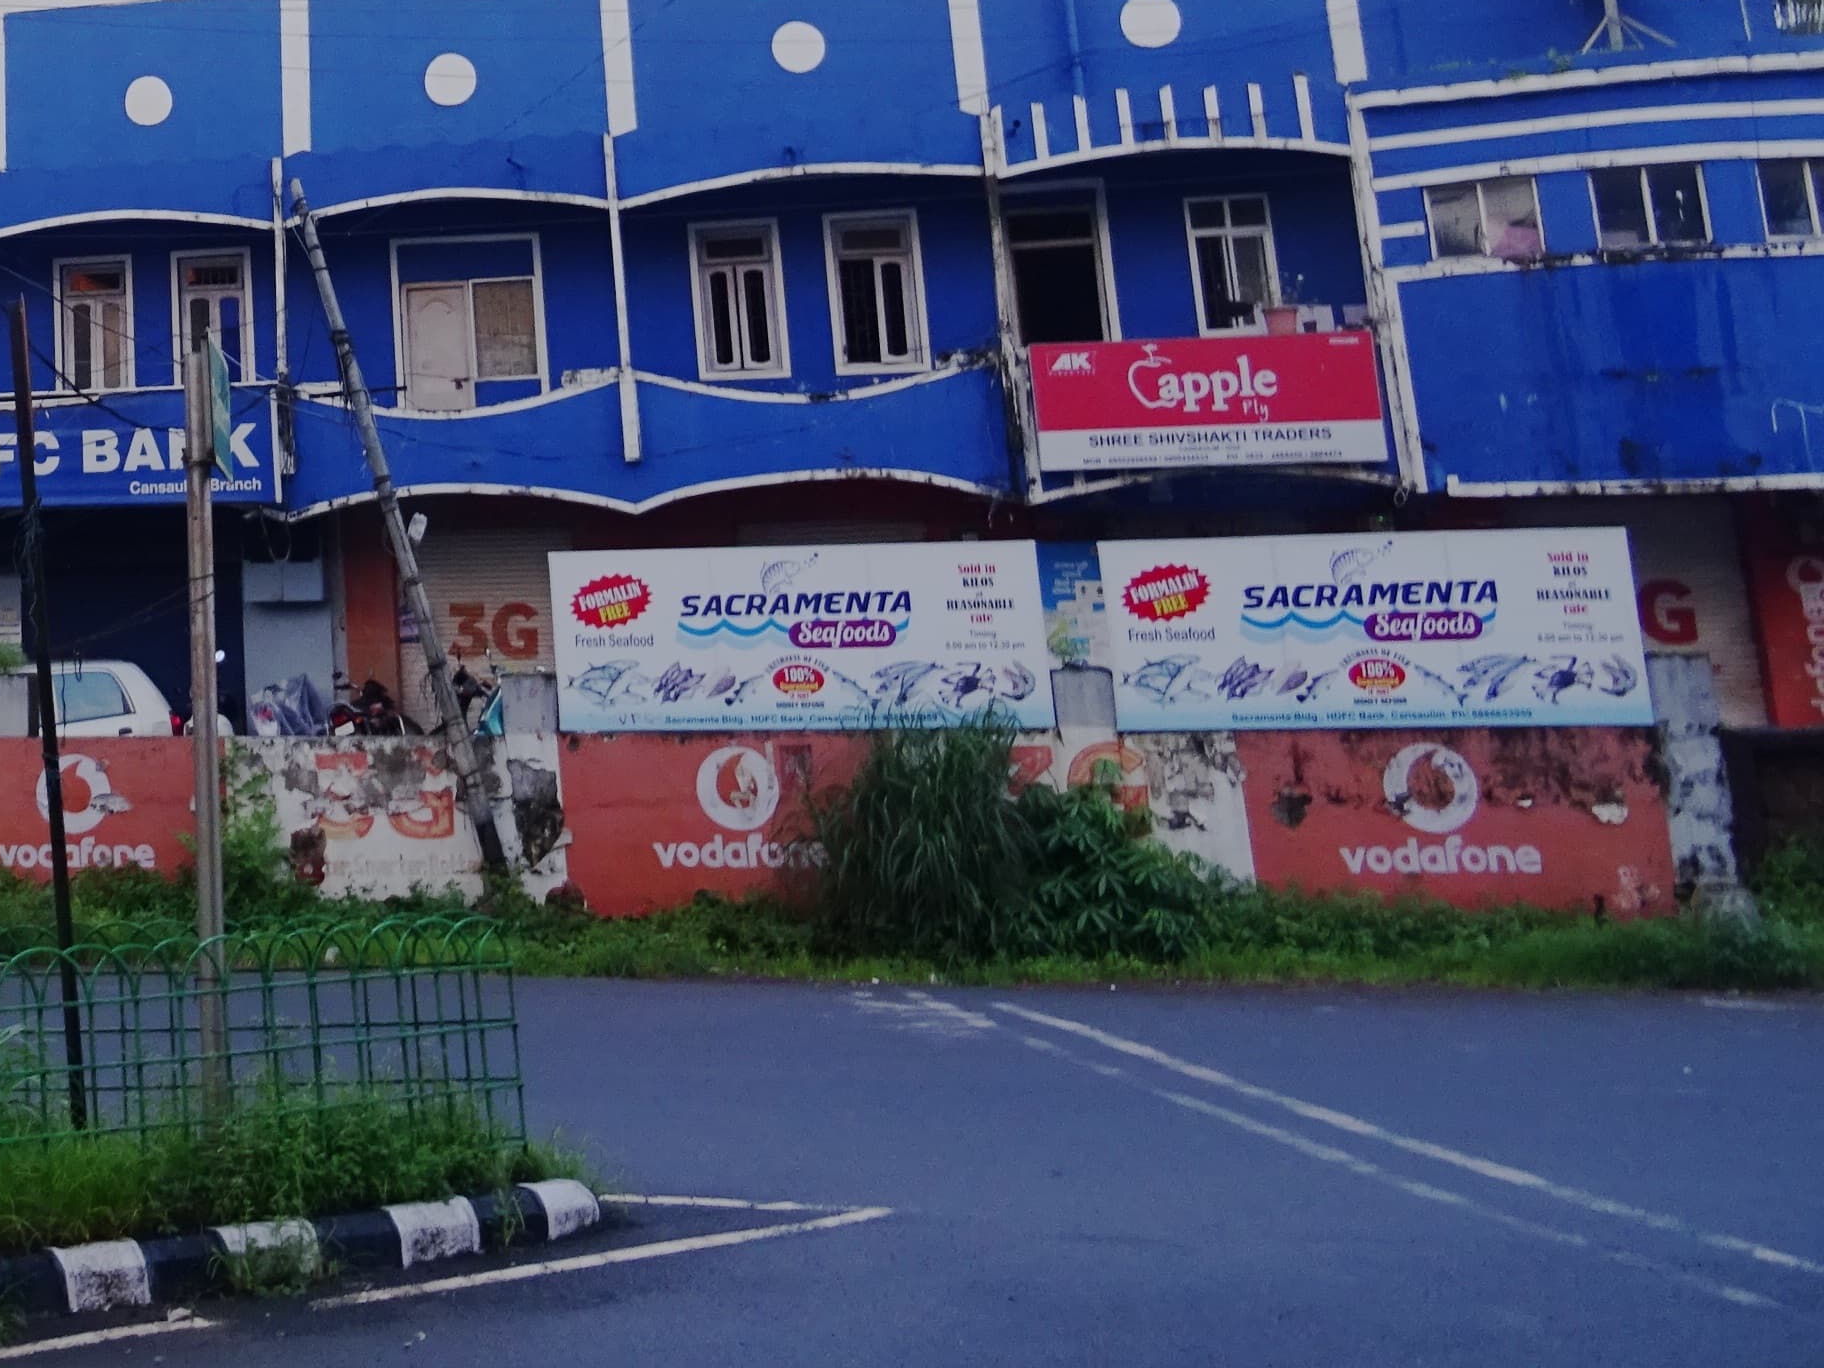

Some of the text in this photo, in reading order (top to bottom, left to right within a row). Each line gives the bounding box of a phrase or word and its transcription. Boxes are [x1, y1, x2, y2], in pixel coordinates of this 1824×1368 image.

[1051, 352, 1091, 371] AK
[1157, 355, 1278, 412] apple
[1089, 426, 1333, 448] SHREE SHIVSHAKTI TRADERS
[129, 477, 262, 495] Cansaul Branch
[1552, 565, 1588, 577] KILOS
[962, 577, 995, 588] KILOS
[1129, 570, 1200, 603] FORMALIN
[578, 580, 643, 613] FORMALIN
[679, 590, 912, 617] SACRAMENTA
[946, 598, 1016, 611] REASONABLE
[1152, 593, 1188, 617] FREE
[1243, 580, 1499, 609] SACRAMENTA
[1536, 589, 1612, 602] REASONABLE
[599, 601, 632, 624] FREE
[448, 600, 539, 660] 3G
[797, 616, 891, 648] Seafoods
[1128, 625, 1216, 642] Fresh Seafood
[1374, 612, 1476, 642] Seafoods
[575, 633, 655, 648] Fresh Seafood
[783, 666, 816, 683] 100%
[1360, 661, 1396, 679] 100%
[1338, 834, 1543, 875] vodafone
